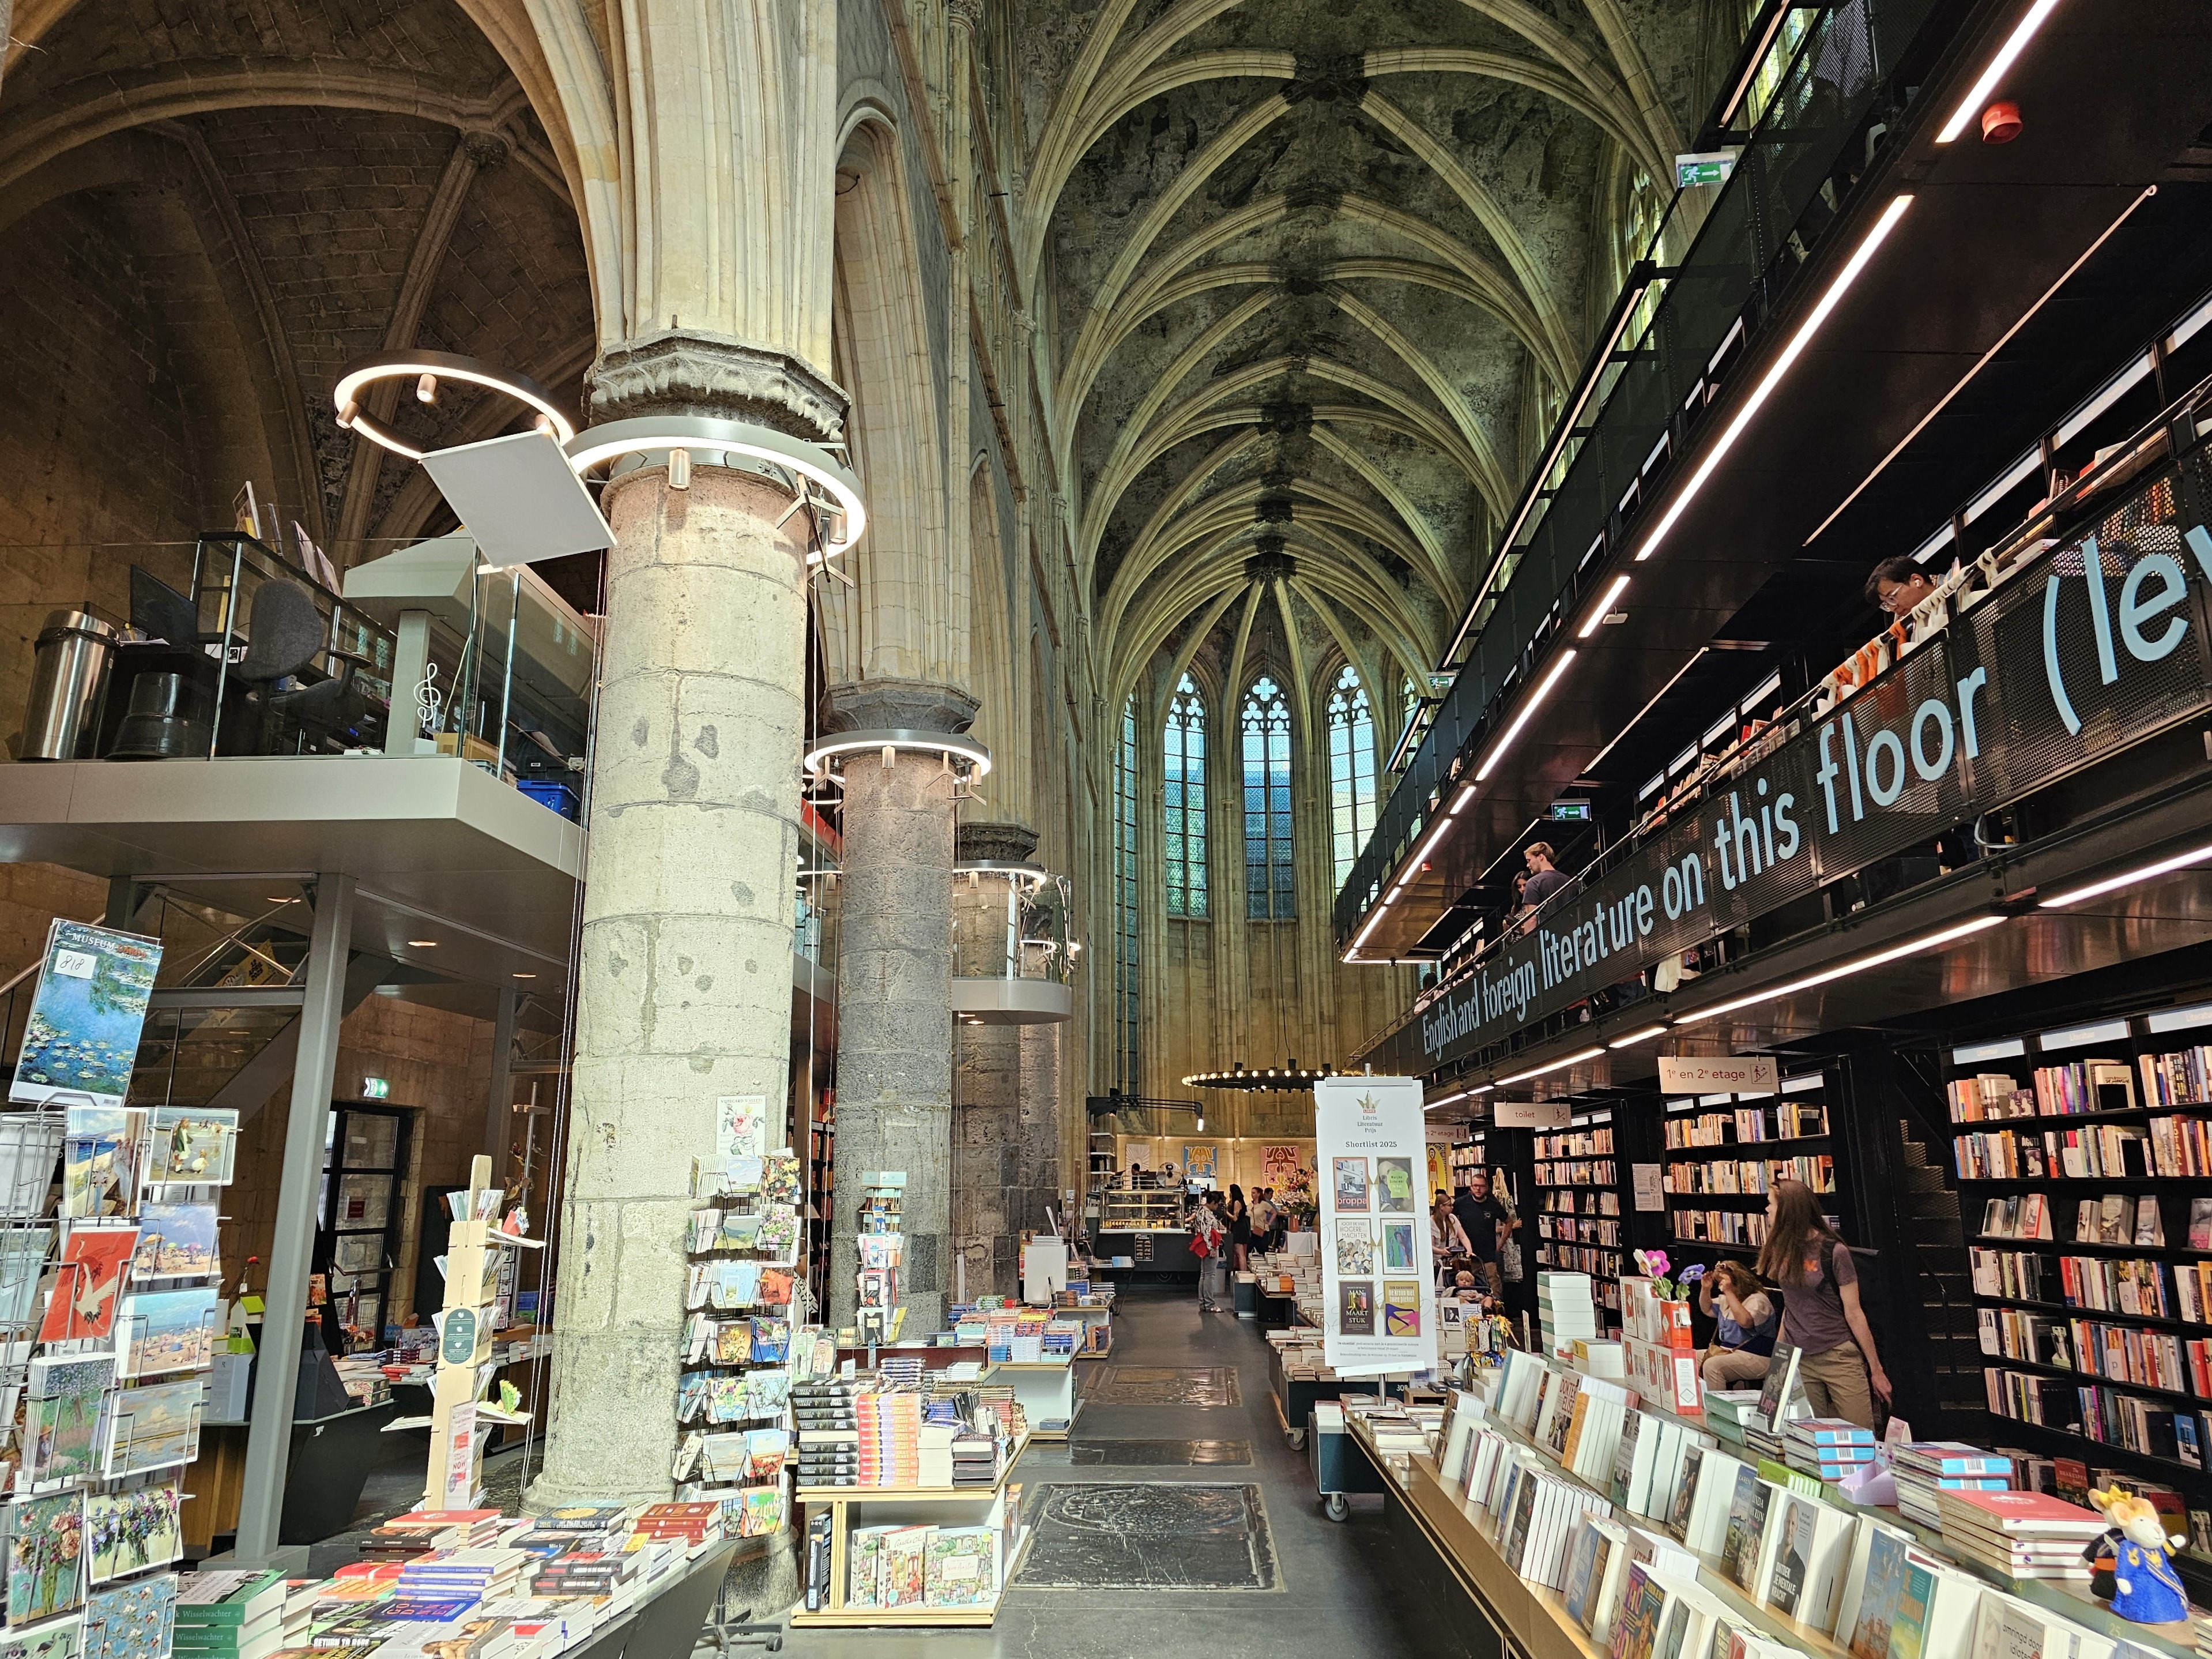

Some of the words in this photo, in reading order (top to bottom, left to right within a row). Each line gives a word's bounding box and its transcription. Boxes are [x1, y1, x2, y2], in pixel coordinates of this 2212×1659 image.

[1422, 995, 1458, 1062] English
[1457, 979, 1480, 1037] and
[1483, 956, 1536, 1022] foreign
[1539, 884, 1653, 991] literature
[1663, 852, 1705, 920] on
[1714, 779, 1799, 891] this
[1817, 667, 1985, 834] floor
[73, 932, 115, 950] MUSEUM
[60, 955, 85, 972] 818
[1680, 1071, 1693, 1079] en
[1712, 1069, 1745, 1081] etage
[1515, 1109, 1535, 1119] toilet
[453, 1460, 466, 1470] NOW
[1776, 1562, 1791, 1579] ONTDEK
[1771, 1586, 1787, 1603] KRACHT
[183, 1609, 231, 1618] Wisselwachter
[176, 1633, 223, 1641] Wisselwachter
[2002, 1623, 2028, 1644] omringd
[2028, 1638, 2043, 1652] door
[2110, 1623, 2121, 1638] 25
